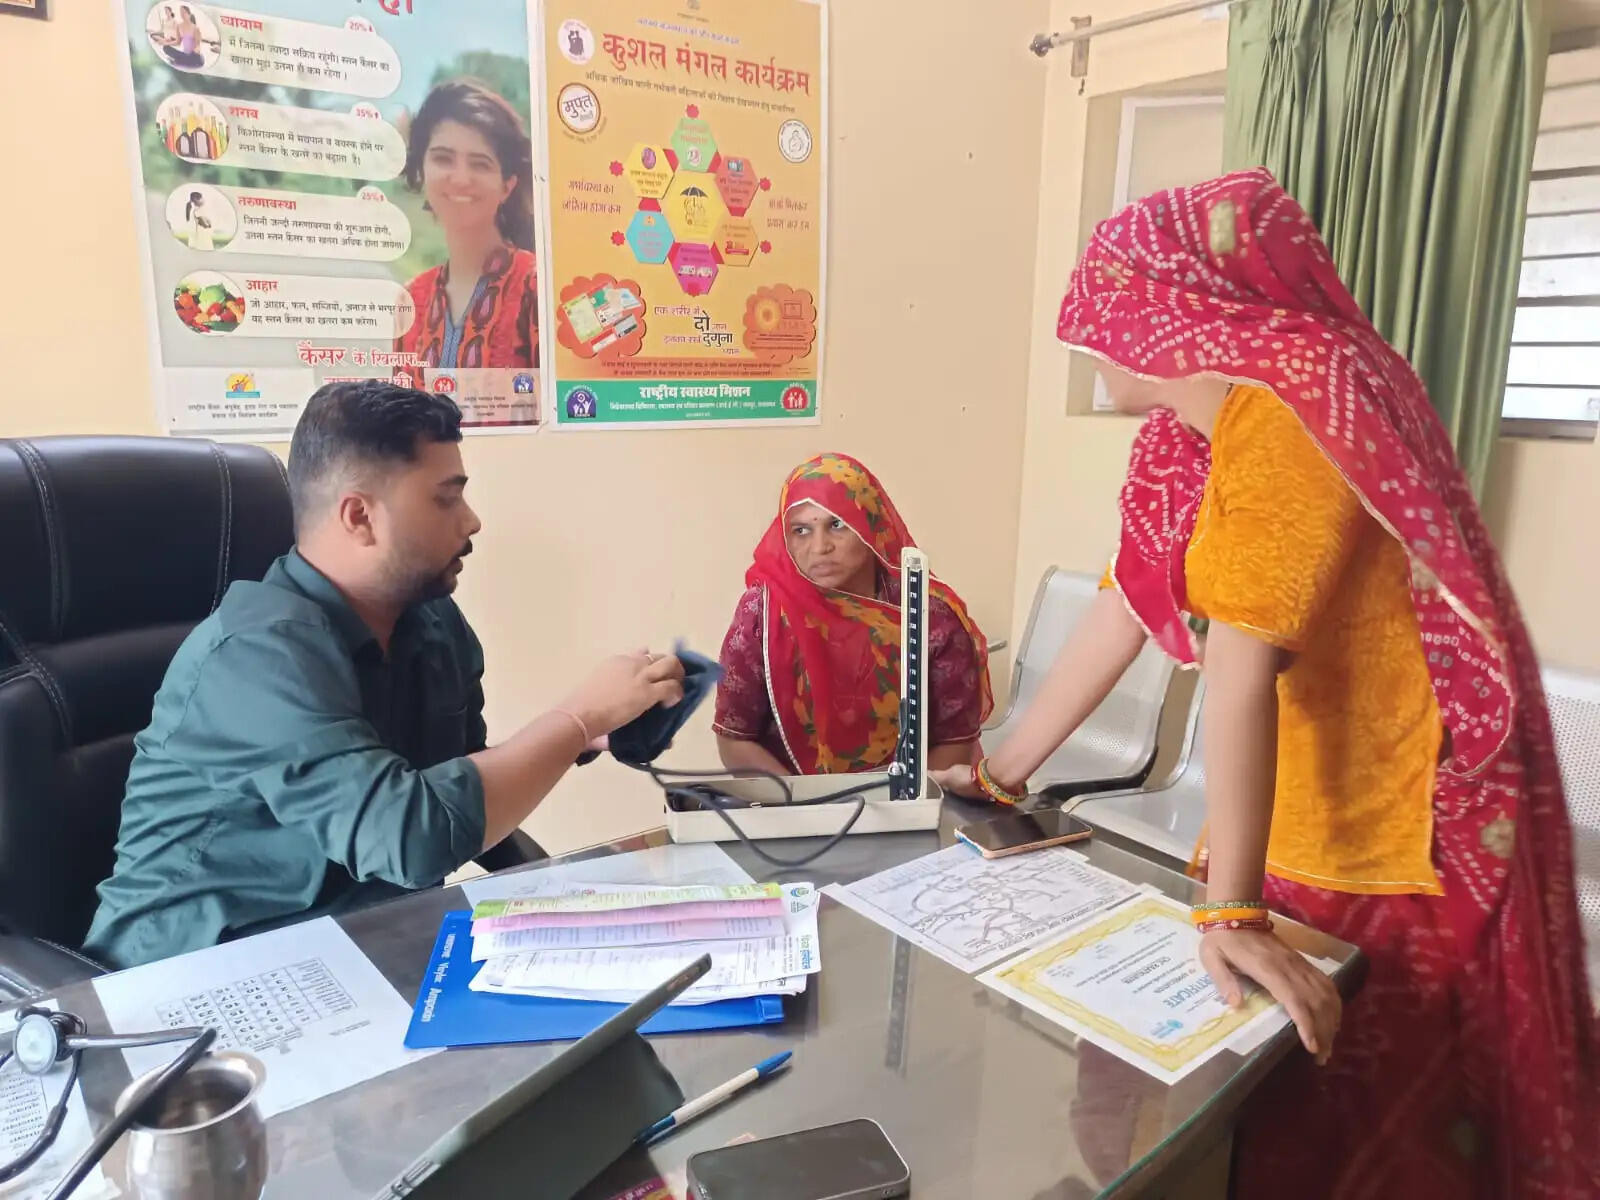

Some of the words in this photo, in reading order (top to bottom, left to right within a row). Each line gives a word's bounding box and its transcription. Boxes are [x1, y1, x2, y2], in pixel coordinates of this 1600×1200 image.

[220, 15, 263, 32] व्यायाम
[239, 37, 264, 51] जितना
[292, 46, 316, 60] सक्रिय
[341, 57, 358, 68] स्तन
[273, 61, 294, 73] उतना
[307, 67, 321, 77] कम
[603, 33, 666, 71] कुशल
[676, 42, 727, 81] मंगल
[735, 56, 810, 97] कार्यक्रम
[229, 106, 259, 120] शराब
[237, 124, 285, 141] किशोरावस्था
[297, 135, 324, 146] मद्यपान
[374, 144, 384, 152] पर
[237, 195, 297, 212] तरुणावस्था
[243, 214, 268, 226] जितनी
[246, 230, 265, 241] उतना
[246, 279, 279, 293] आहार
[250, 297, 261, 309] जो
[340, 317, 354, 327] कम
[693, 310, 711, 332] दो
[702, 333, 733, 348] दुगुना
[297, 340, 347, 366] कैंसर
[352, 347, 367, 366] के
[639, 383, 678, 400] राष्ट्रीय
[680, 385, 718, 398] स्वास्थ्य
[719, 383, 751, 397] मिशन
